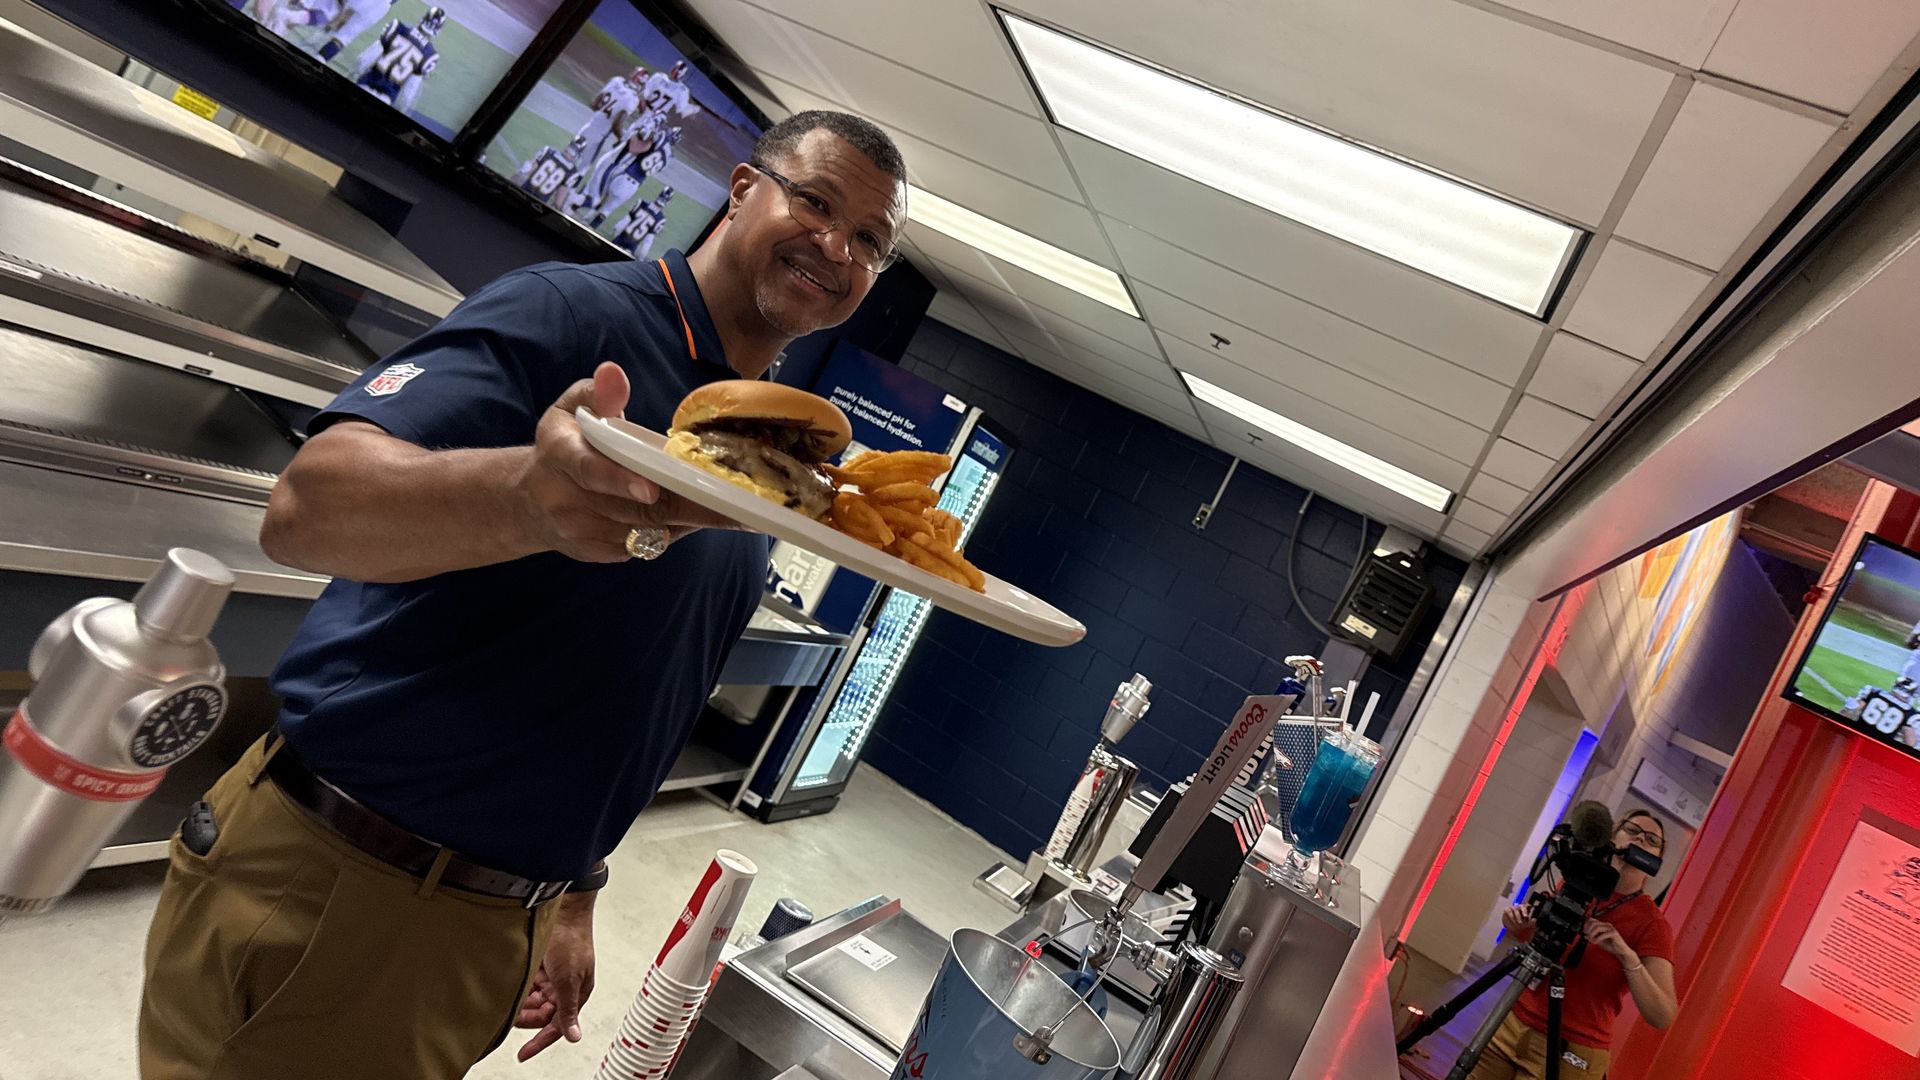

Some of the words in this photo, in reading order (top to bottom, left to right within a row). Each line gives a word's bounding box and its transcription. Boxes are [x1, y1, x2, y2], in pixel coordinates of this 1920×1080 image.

[377, 35, 424, 84] 75
[648, 90, 673, 115] 27
[530, 159, 566, 196] 68
[626, 209, 654, 241] 75
[829, 395, 853, 412] purely
[852, 405, 888, 429] balanced
[886, 422, 923, 448] hydration.
[833, 386, 858, 403] purely
[857, 395, 893, 419] balanced
[891, 414, 903, 426] pH
[902, 417, 916, 431] for
[1228, 703, 1268, 747] Coors
[1862, 697, 1905, 734] 68
[72, 773, 117, 793] SPICY
